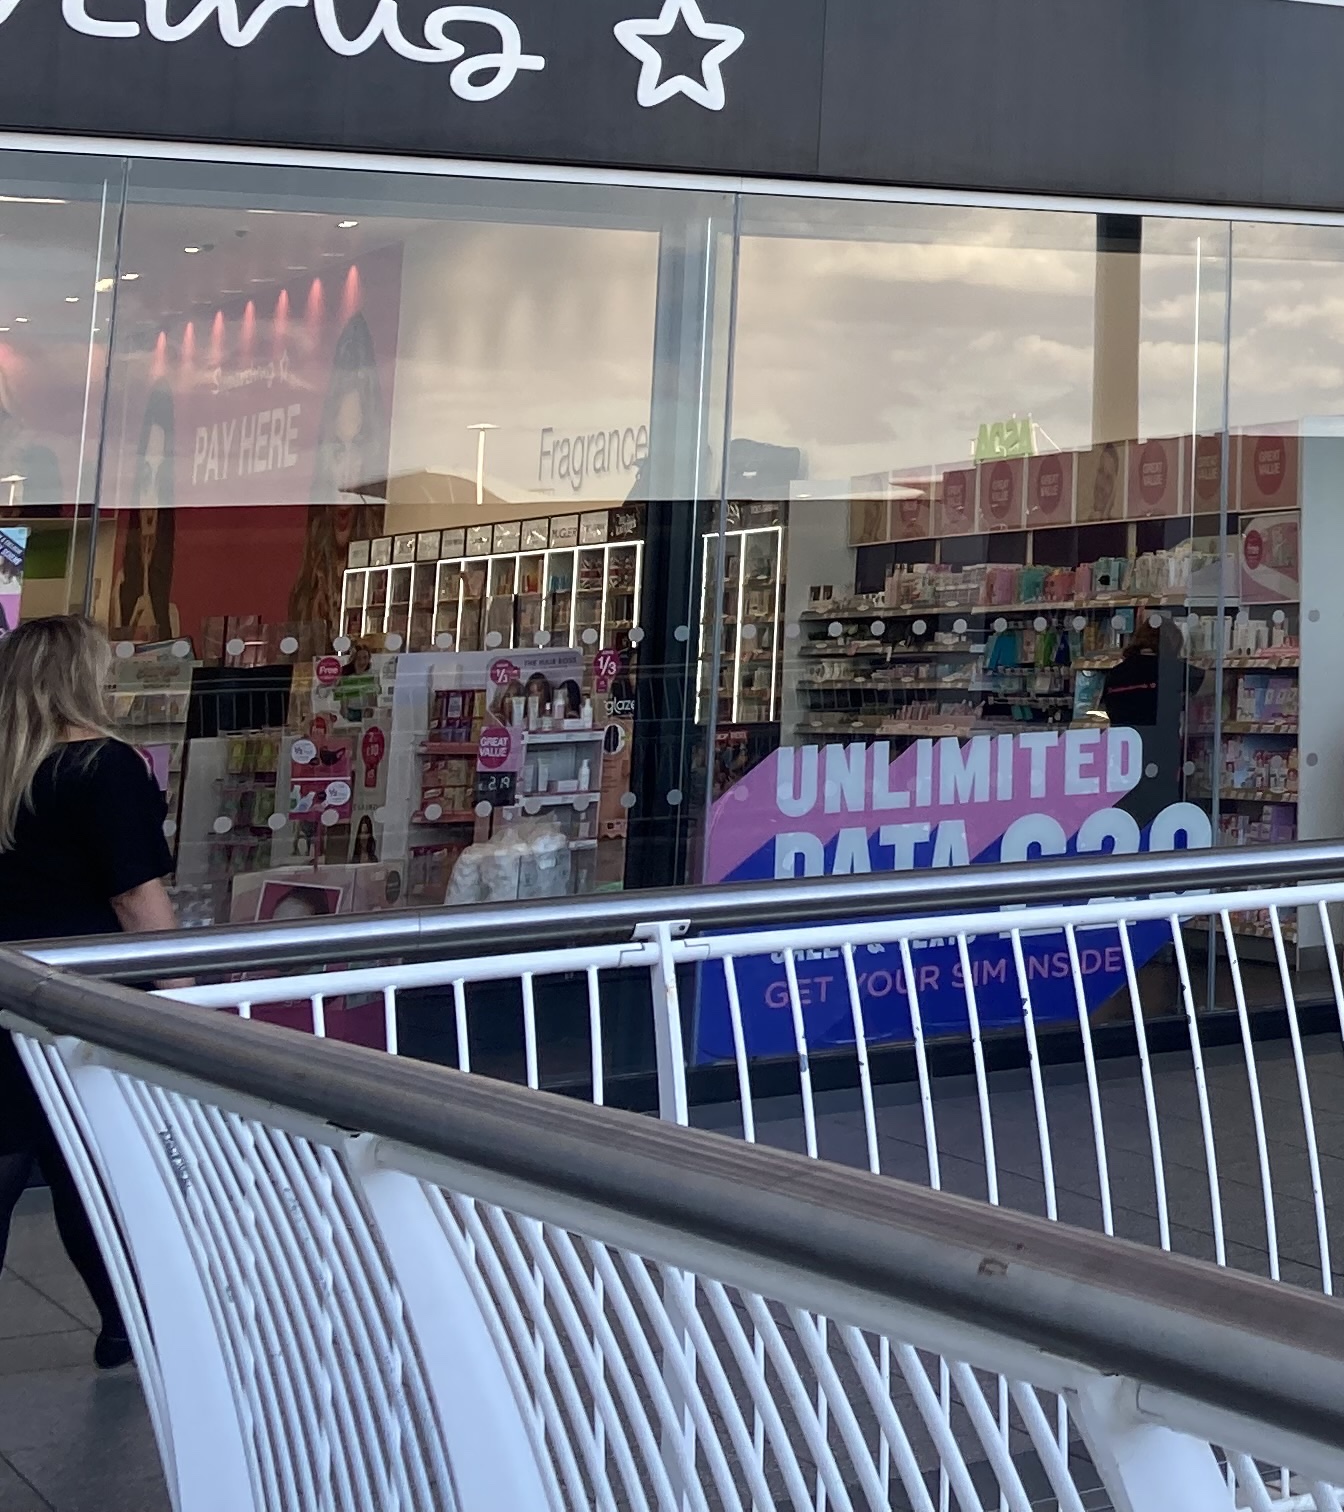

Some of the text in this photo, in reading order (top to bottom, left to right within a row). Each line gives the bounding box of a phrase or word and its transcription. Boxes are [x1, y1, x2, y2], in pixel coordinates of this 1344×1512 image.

[192, 403, 301, 486] PAY HERE
[539, 423, 647, 488] Fragrance
[479, 747, 507, 757] VALUE
[480, 737, 508, 747] GREAT
[775, 727, 1143, 817] UNLIMITED
[765, 975, 834, 1009] GET
[952, 959, 1006, 989] SIM
[1025, 947, 1122, 980] NSDE
